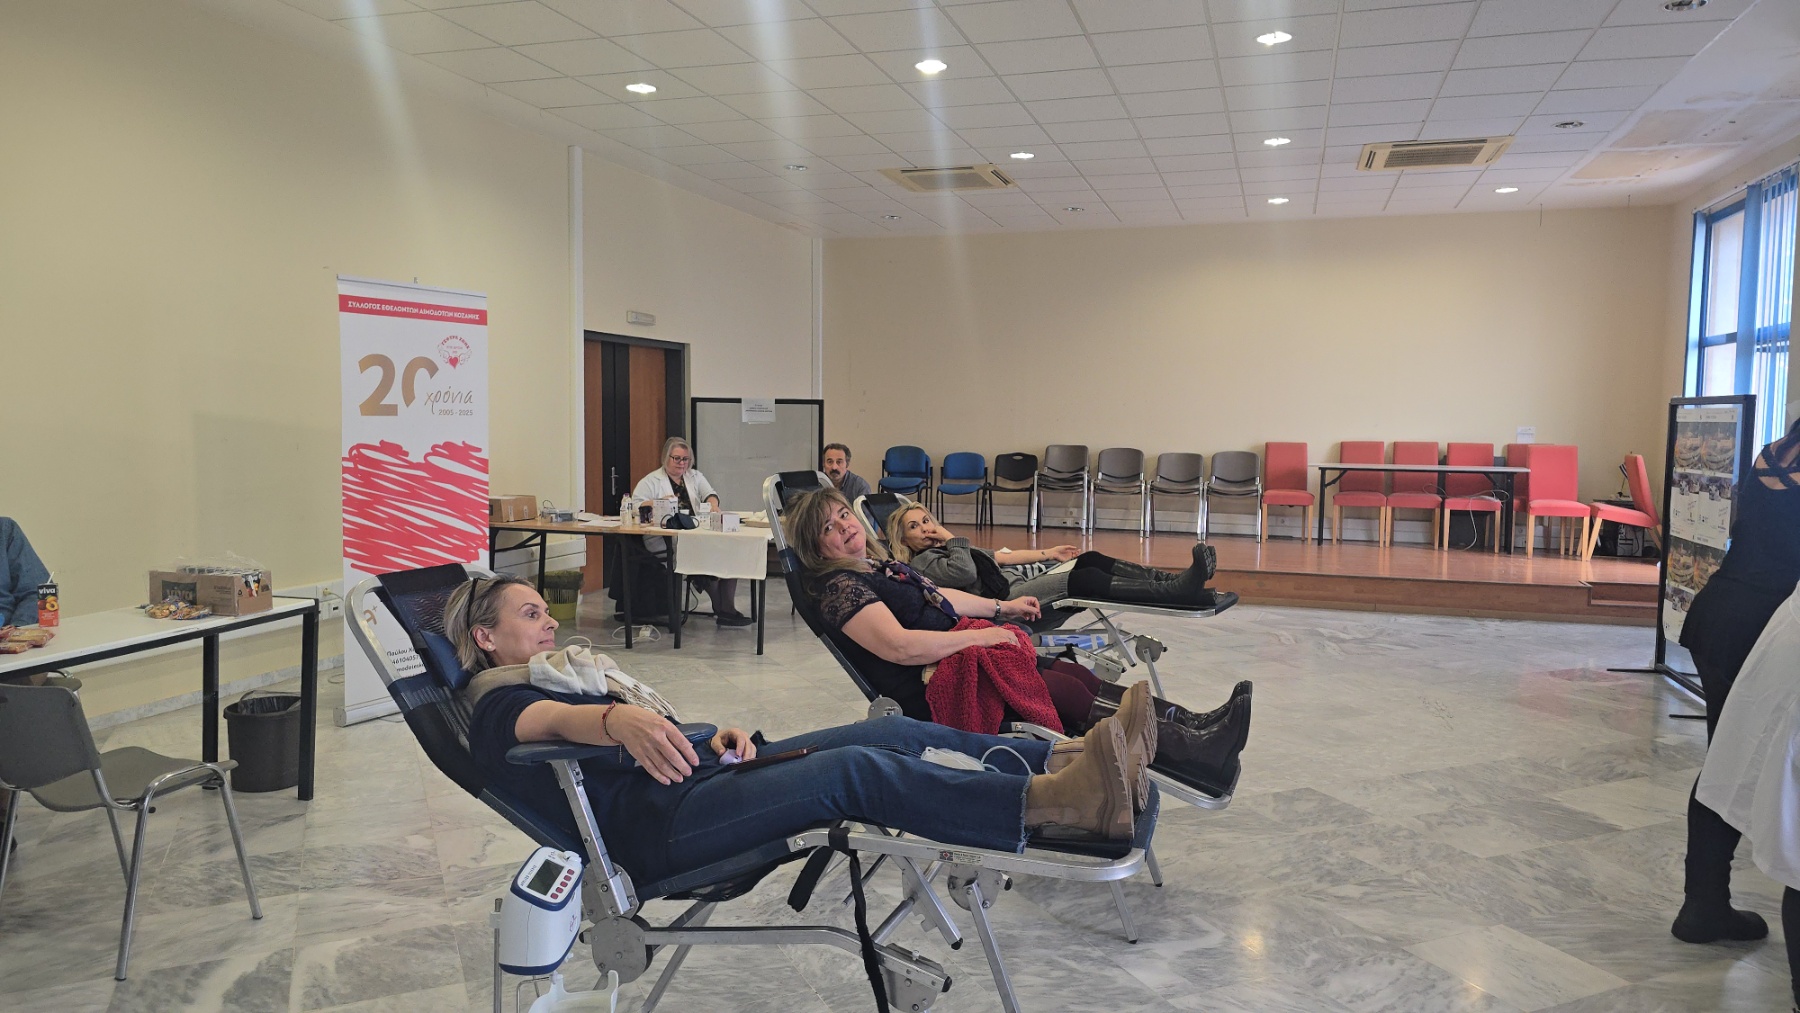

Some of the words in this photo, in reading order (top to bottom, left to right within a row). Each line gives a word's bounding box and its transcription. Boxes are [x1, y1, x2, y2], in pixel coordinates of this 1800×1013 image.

[348, 301, 381, 310] ΣΥΛΛΟΓΟΣ
[382, 304, 418, 313] ΕΘΕΛΟΝΤΩΝ
[419, 308, 453, 317] ΑΙΜΟΔΟΤΩΝ
[454, 311, 480, 320] ΚΟΖΑΝΗΣ
[424, 386, 472, 415] χρόνια
